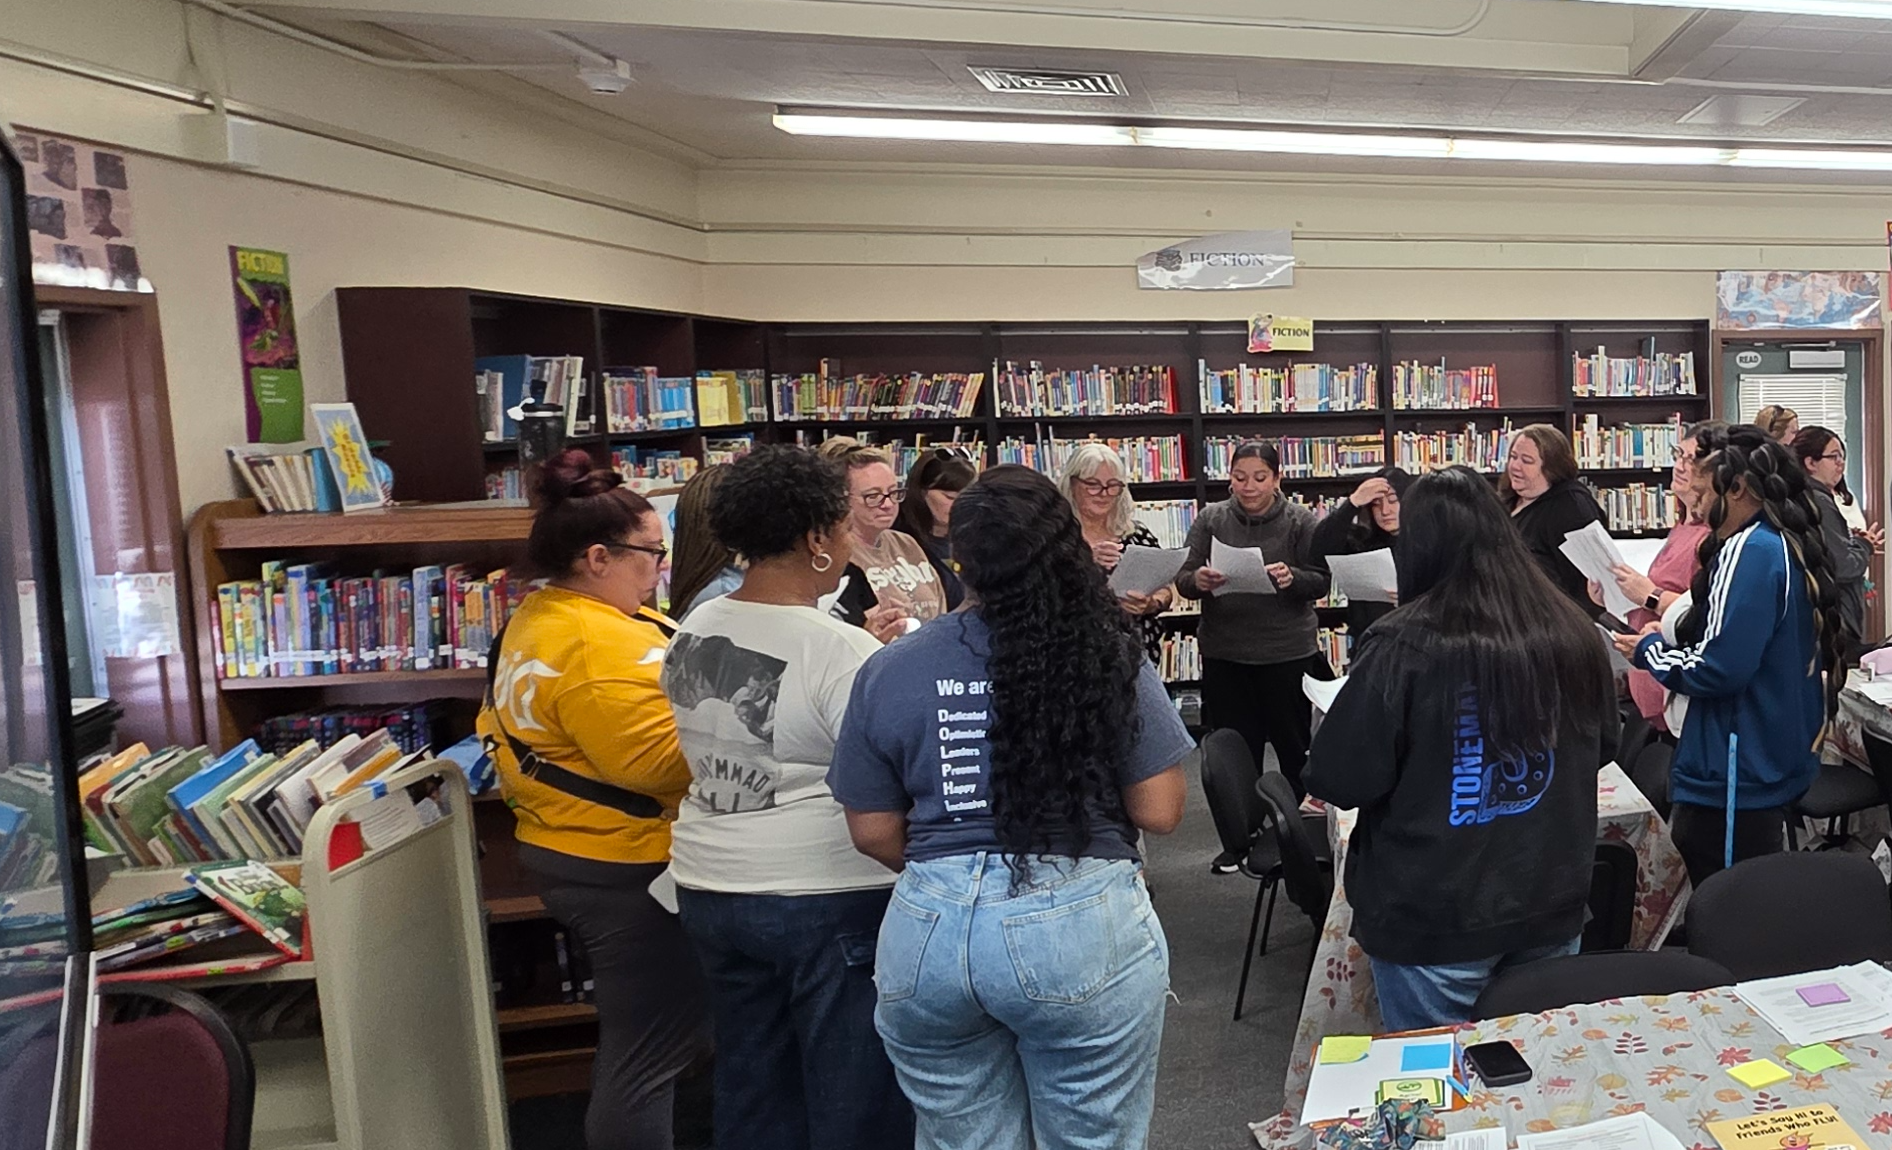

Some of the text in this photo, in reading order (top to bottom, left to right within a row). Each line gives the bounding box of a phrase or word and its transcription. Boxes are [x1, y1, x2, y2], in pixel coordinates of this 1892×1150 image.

[237, 251, 285, 274] FICTION
[1189, 252, 1265, 268] FICTION
[1272, 328, 1310, 337] FICTION
[936, 679, 964, 696] We
[943, 781, 976, 795] Happy
[1736, 1126, 1783, 1140] Friends
[1784, 1121, 1811, 1132] Who
[1737, 1119, 1768, 1131] Let's
[1770, 1114, 1793, 1125] Say
